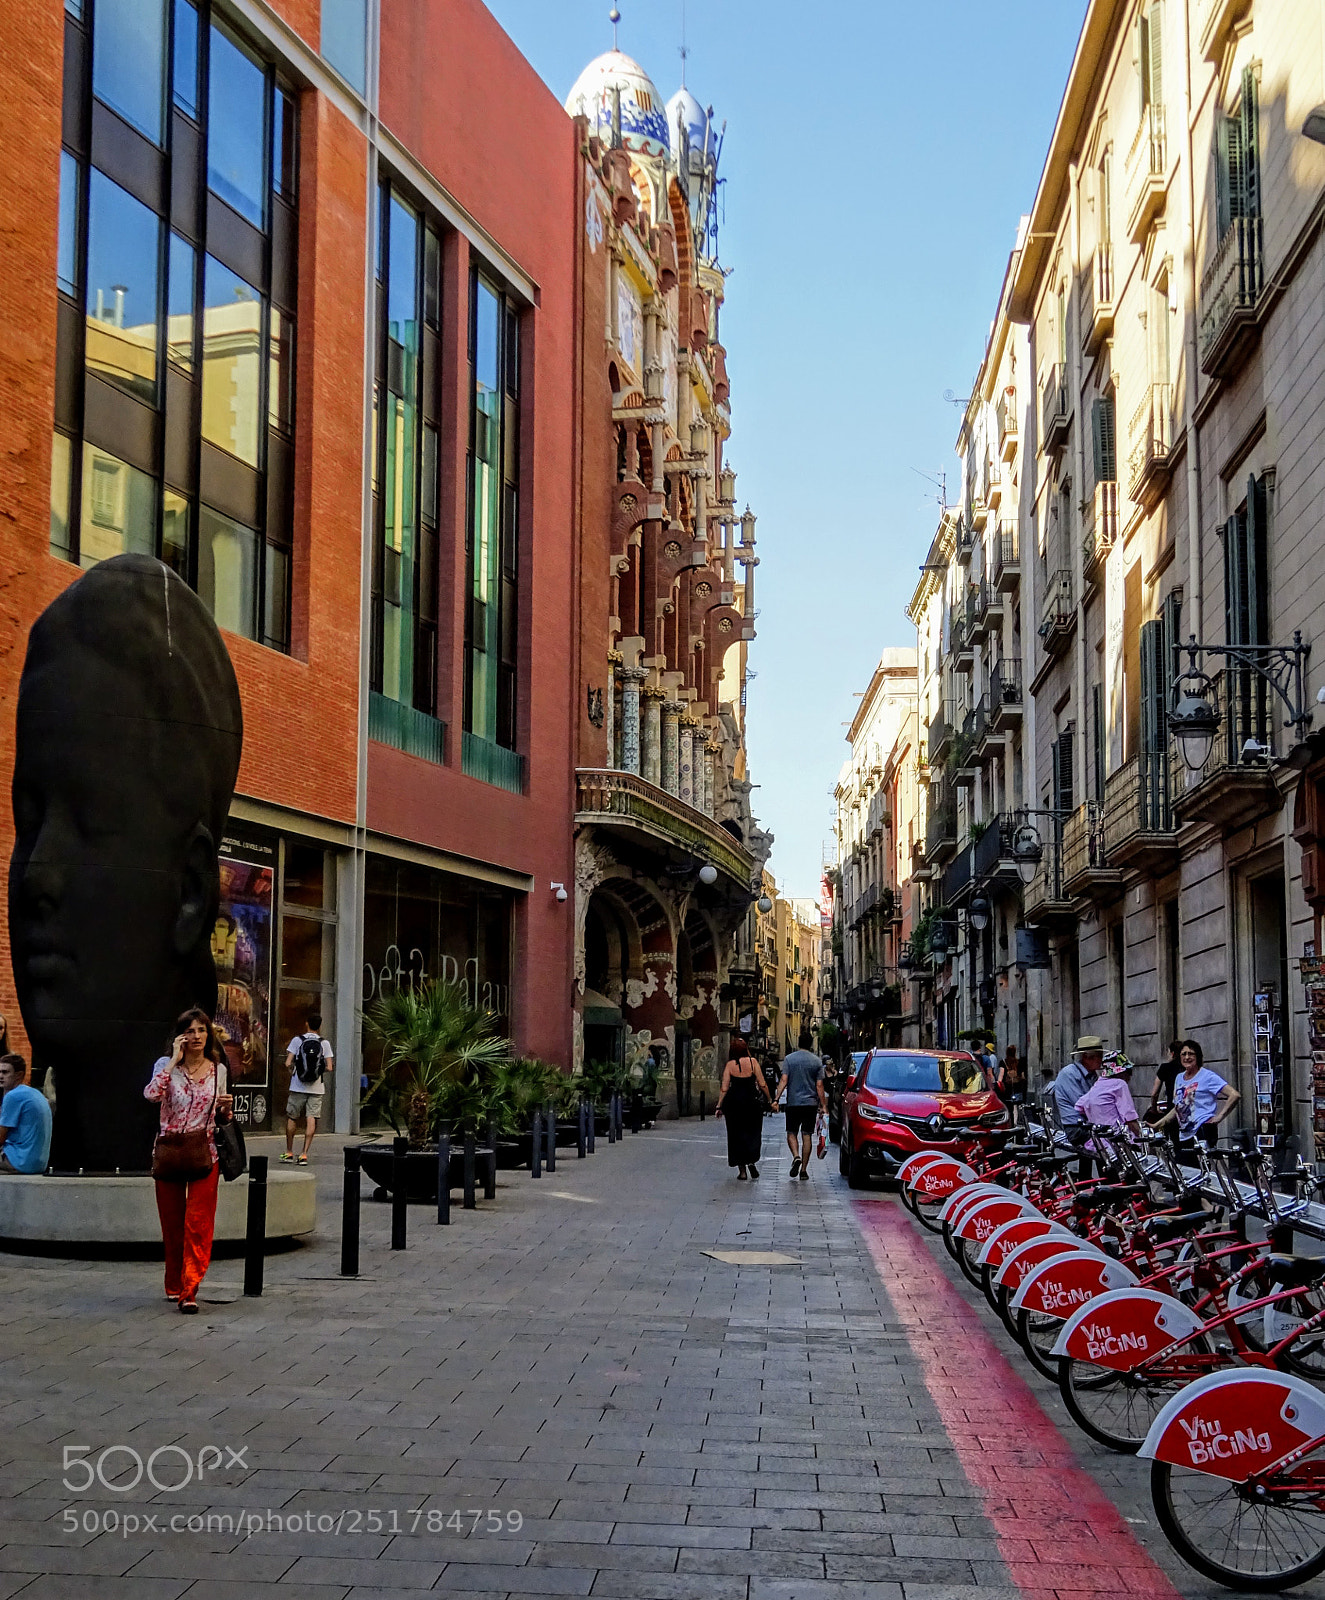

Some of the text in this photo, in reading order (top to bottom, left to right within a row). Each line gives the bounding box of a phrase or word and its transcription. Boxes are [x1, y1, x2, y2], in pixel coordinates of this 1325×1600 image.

[233, 1094, 249, 1112] 125
[922, 1174, 938, 1183] Viu
[972, 1217, 991, 1229] Viu
[1036, 1279, 1063, 1296] Viu
[1080, 1323, 1112, 1342] Viu
[1086, 1331, 1149, 1360] BiCiNg
[1178, 1415, 1222, 1441] Viu
[1187, 1427, 1273, 1465] BiCiNg
